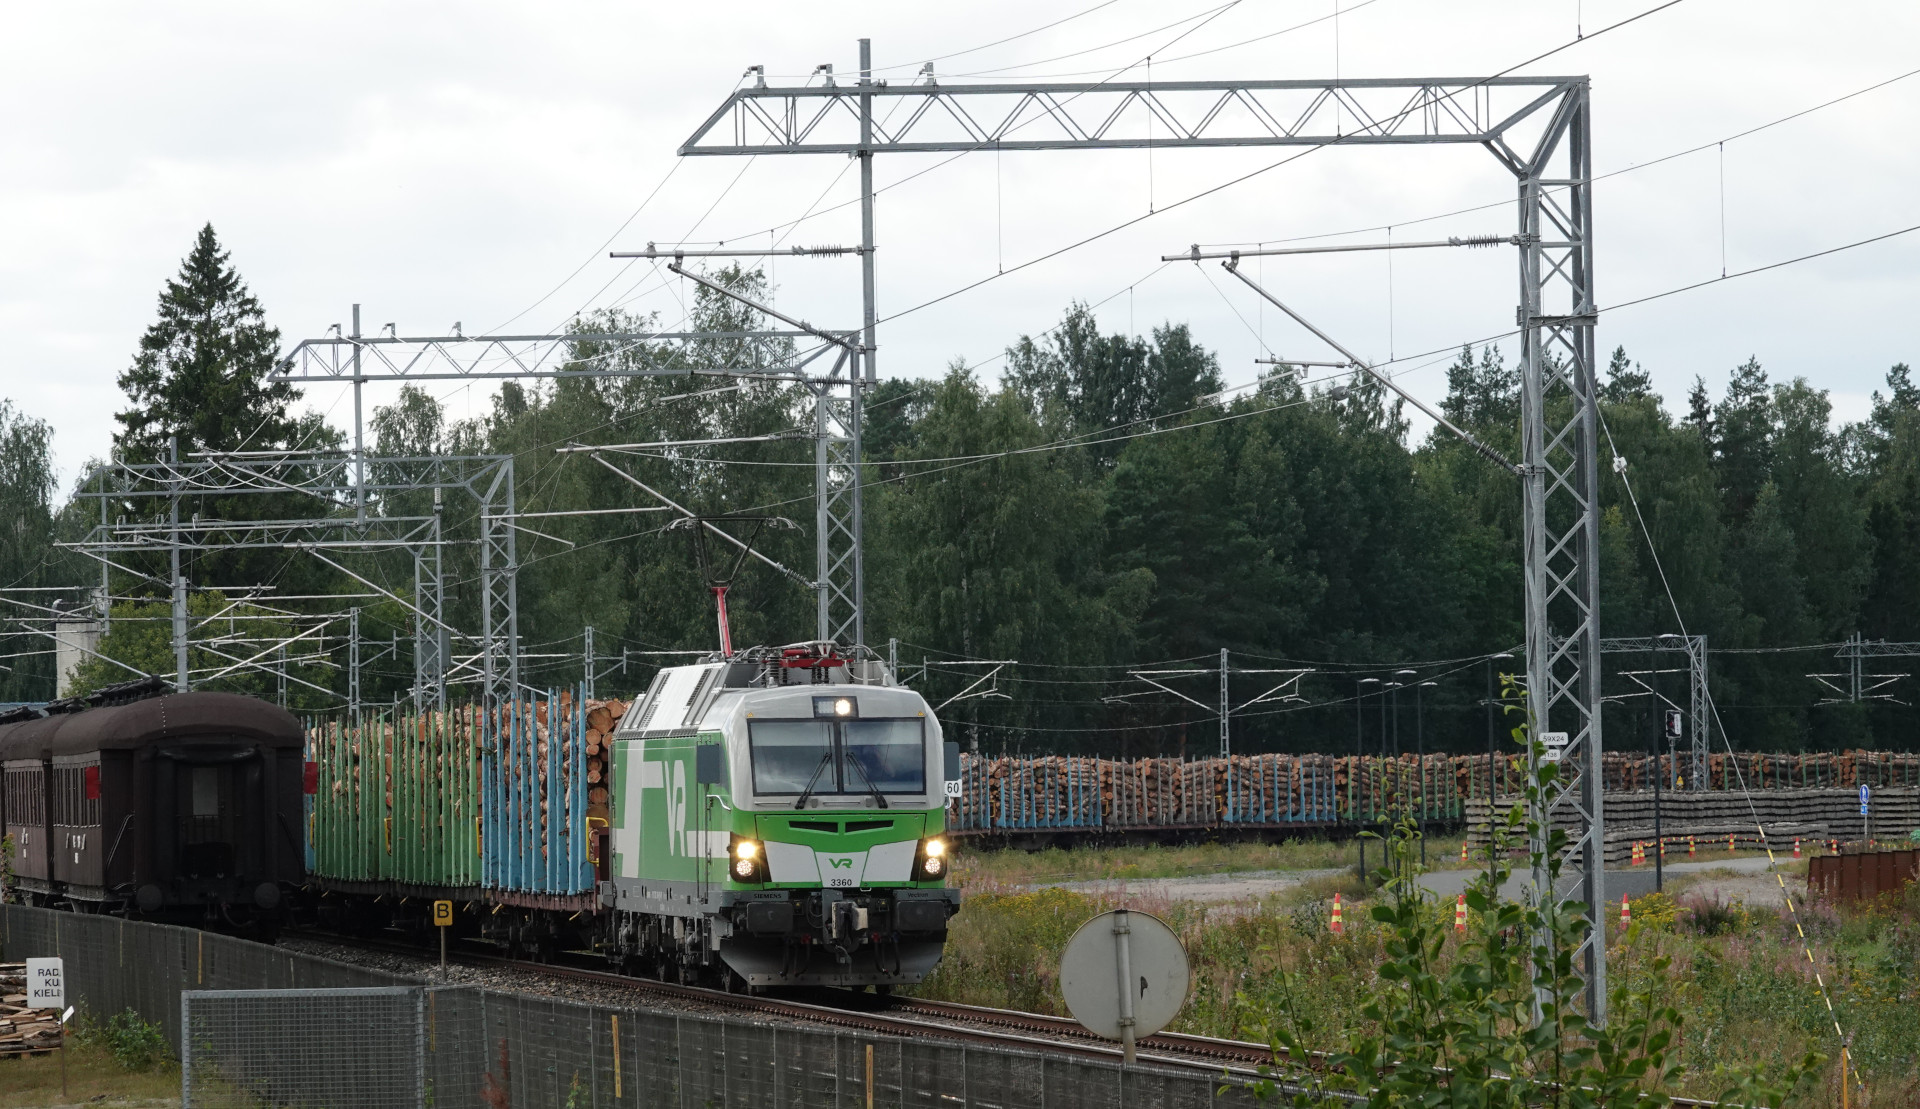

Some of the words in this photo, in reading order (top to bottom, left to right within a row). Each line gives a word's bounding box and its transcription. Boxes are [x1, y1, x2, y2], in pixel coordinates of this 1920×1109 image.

[947, 782, 960, 794] 60
[664, 759, 687, 857] VR
[828, 858, 853, 869] VR
[830, 878, 853, 887] 3360
[437, 903, 450, 918] B
